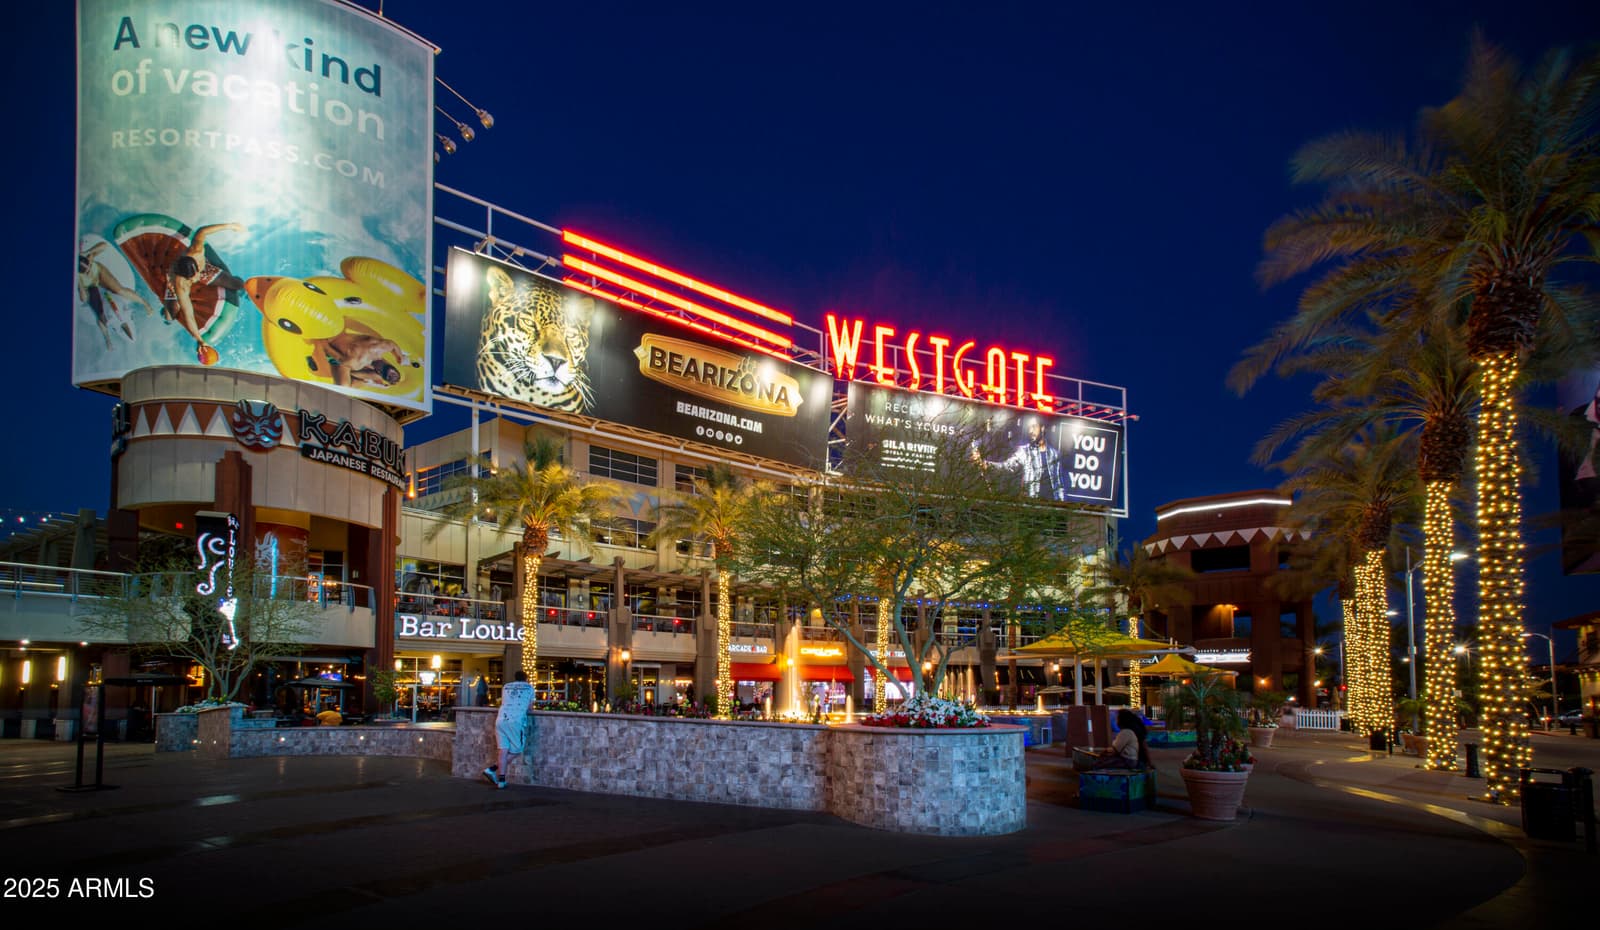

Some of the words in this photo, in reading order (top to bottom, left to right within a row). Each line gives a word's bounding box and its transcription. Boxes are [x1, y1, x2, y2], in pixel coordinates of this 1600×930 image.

[113, 16, 141, 51] A
[154, 22, 255, 57] new
[111, 59, 153, 97] of
[162, 67, 385, 141] vacation
[111, 127, 385, 189] RESORTPASS.COM
[649, 346, 791, 408] BEARIZONA
[826, 313, 1054, 413] WESTGATE
[676, 401, 763, 434] BEARIZONA.COM
[865, 413, 912, 429] WHAT'S
[916, 421, 955, 435] YOURS
[299, 409, 405, 473] KABUK
[882, 439, 905, 450] GILA
[1072, 434, 1106, 453] YOU
[309, 448, 367, 473] JAPANESE
[1073, 453, 1099, 471] DO
[1069, 472, 1102, 490] YOU
[400, 616, 452, 638] Bar
